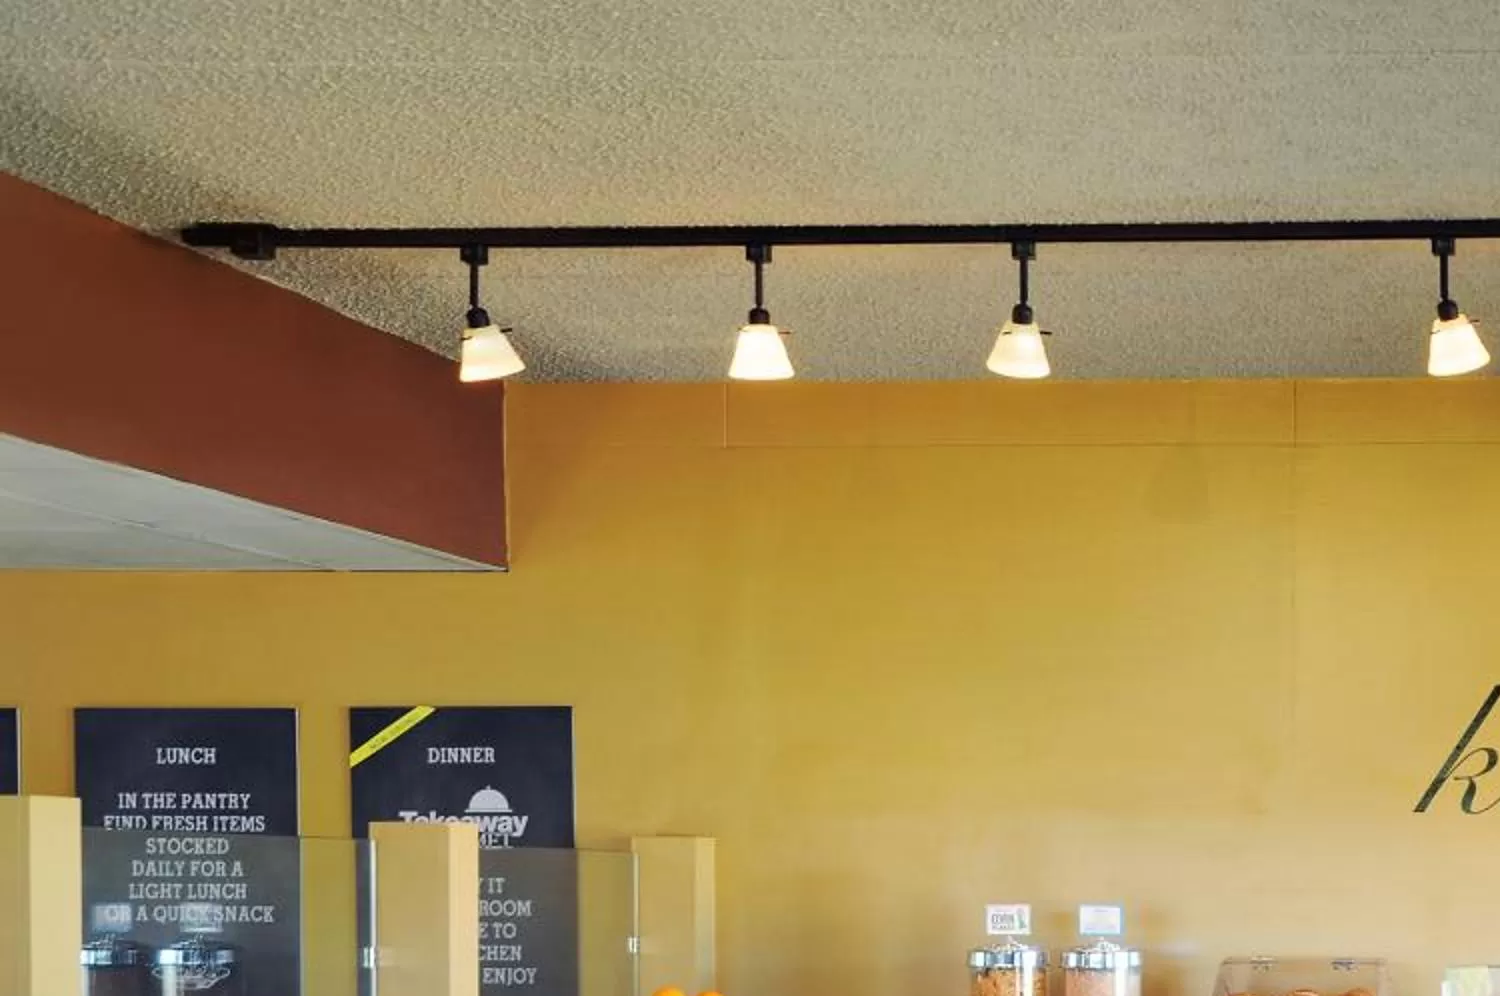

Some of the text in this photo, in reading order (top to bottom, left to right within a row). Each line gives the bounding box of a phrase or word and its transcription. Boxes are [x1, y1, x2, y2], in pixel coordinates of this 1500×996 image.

[156, 747, 217, 765] LUNCH
[427, 747, 496, 764] DINNER
[117, 792, 251, 809] IN THE PANTRY
[103, 815, 266, 833] FIND FRESH ITEMS
[145, 837, 230, 855] STOCKED
[131, 860, 244, 877] DAILY FOR A
[128, 882, 248, 900] LIGHT LUNCH
[487, 877, 505, 894] IT
[136, 905, 148, 921] A
[214, 905, 275, 923] SNACK
[480, 900, 532, 916] ROOM
[492, 922, 517, 939] TO
[483, 967, 537, 985] ENJOY
